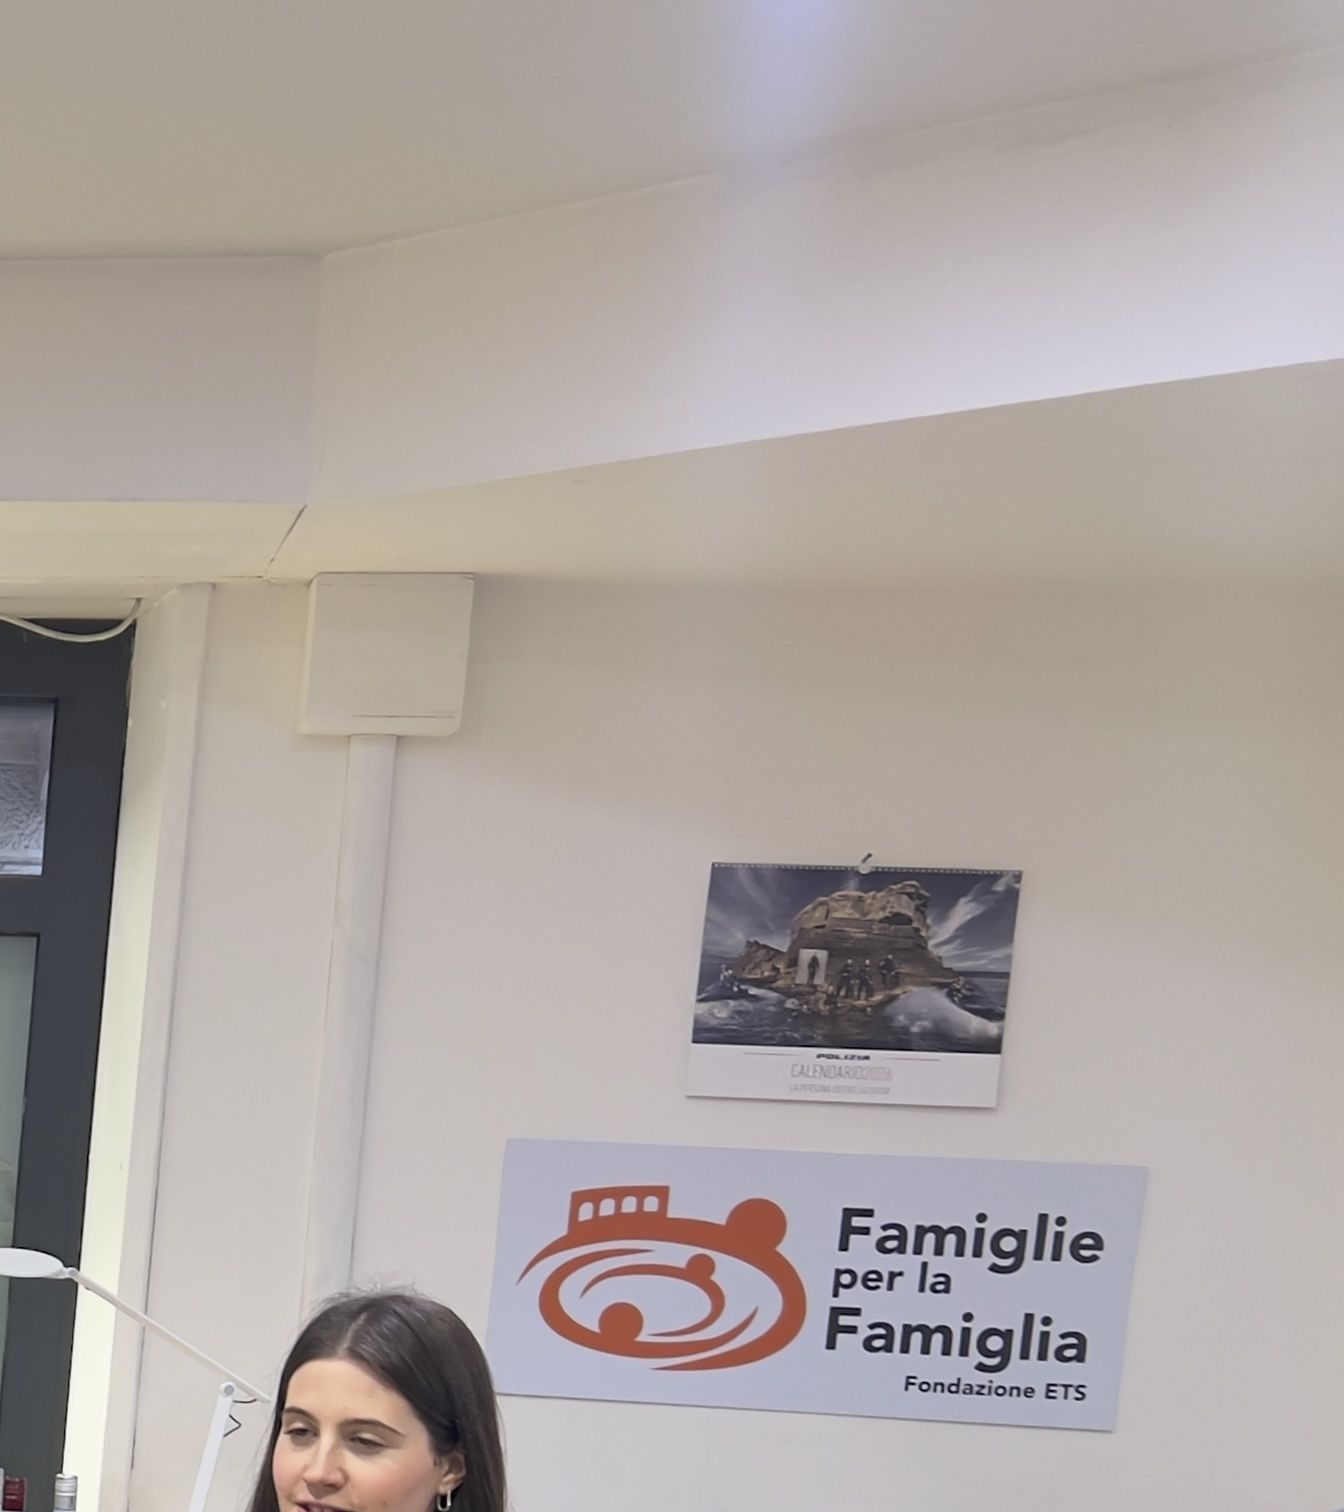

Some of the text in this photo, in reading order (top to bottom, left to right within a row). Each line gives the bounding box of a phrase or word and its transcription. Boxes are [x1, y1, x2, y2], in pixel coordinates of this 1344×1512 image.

[837, 1207, 1105, 1274] Famiglie
[832, 1262, 953, 1298] per la
[824, 1305, 1088, 1373] Famiglia
[903, 1376, 1088, 1402] Fondazione ETS
